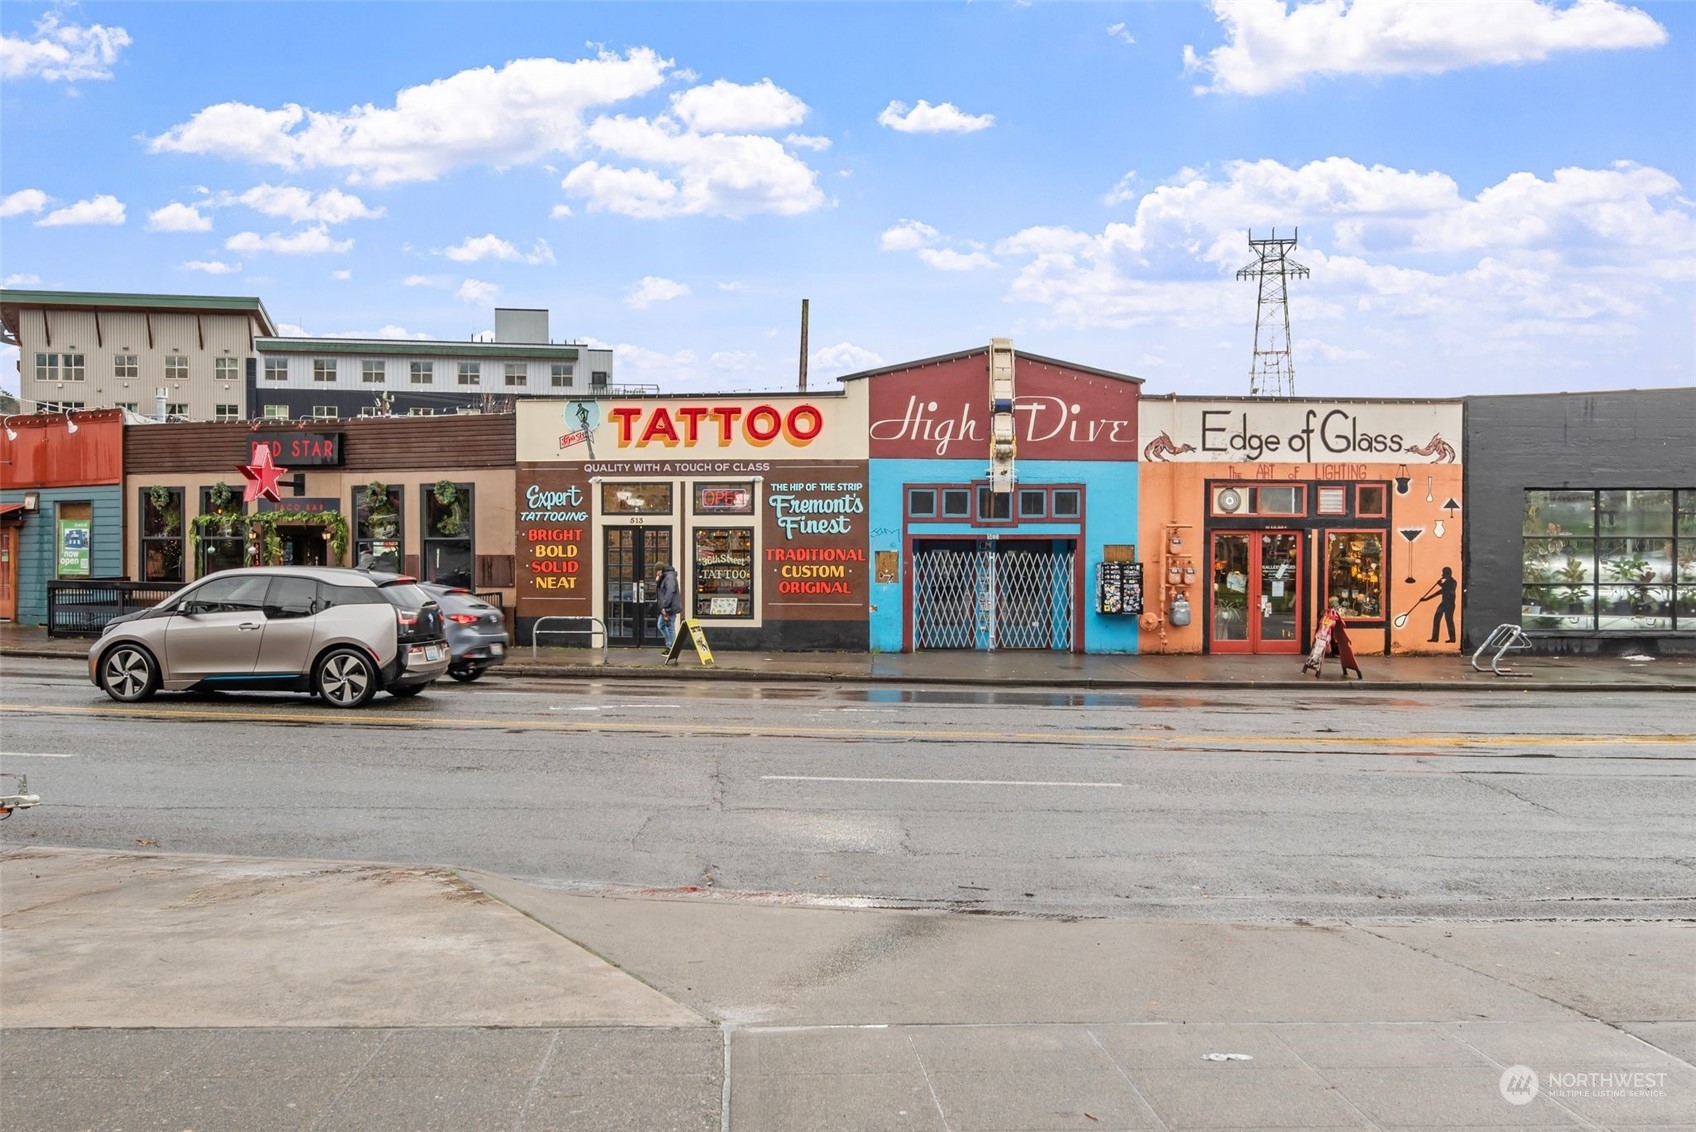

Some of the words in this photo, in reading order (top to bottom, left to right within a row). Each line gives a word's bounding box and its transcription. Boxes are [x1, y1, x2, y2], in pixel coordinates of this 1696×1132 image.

[608, 405, 825, 448] TATTOO
[869, 395, 984, 455] High
[1014, 395, 1135, 442] Dive
[1202, 410, 1281, 461] Edge
[1288, 409, 1318, 463] of
[1320, 409, 1404, 453] Glass
[291, 440, 334, 458] STAR
[583, 463, 632, 473] QUALITY
[633, 462, 660, 473] WITH
[662, 462, 672, 472] A
[674, 462, 712, 472] TOUCH
[714, 462, 730, 472] OF
[732, 462, 770, 471] CLASS
[1256, 463, 1276, 480] ART
[1314, 463, 1367, 480] LIGHTING
[770, 483, 788, 491] THE
[789, 483, 804, 491] HIP
[805, 483, 817, 491] OF
[819, 483, 836, 491] THE
[837, 482, 863, 491] STRIP
[526, 485, 583, 510] Expert
[703, 490, 746, 506] OPEN
[274, 503, 301, 511] TACO
[768, 493, 864, 518] Fremont's
[520, 511, 589, 522] TATTOOING
[777, 515, 852, 540] Finest
[528, 529, 583, 541] BRIGHT
[535, 544, 578, 558] BOLD
[765, 548, 866, 561] TRADITIONAL
[60, 558, 79, 566] open
[531, 560, 579, 573] SOLID
[720, 554, 745, 566] Street
[702, 569, 746, 579] TATTOO
[781, 564, 845, 578] CUSTOM
[535, 576, 577, 589] NEAT
[778, 581, 851, 594] ORIGINAL
